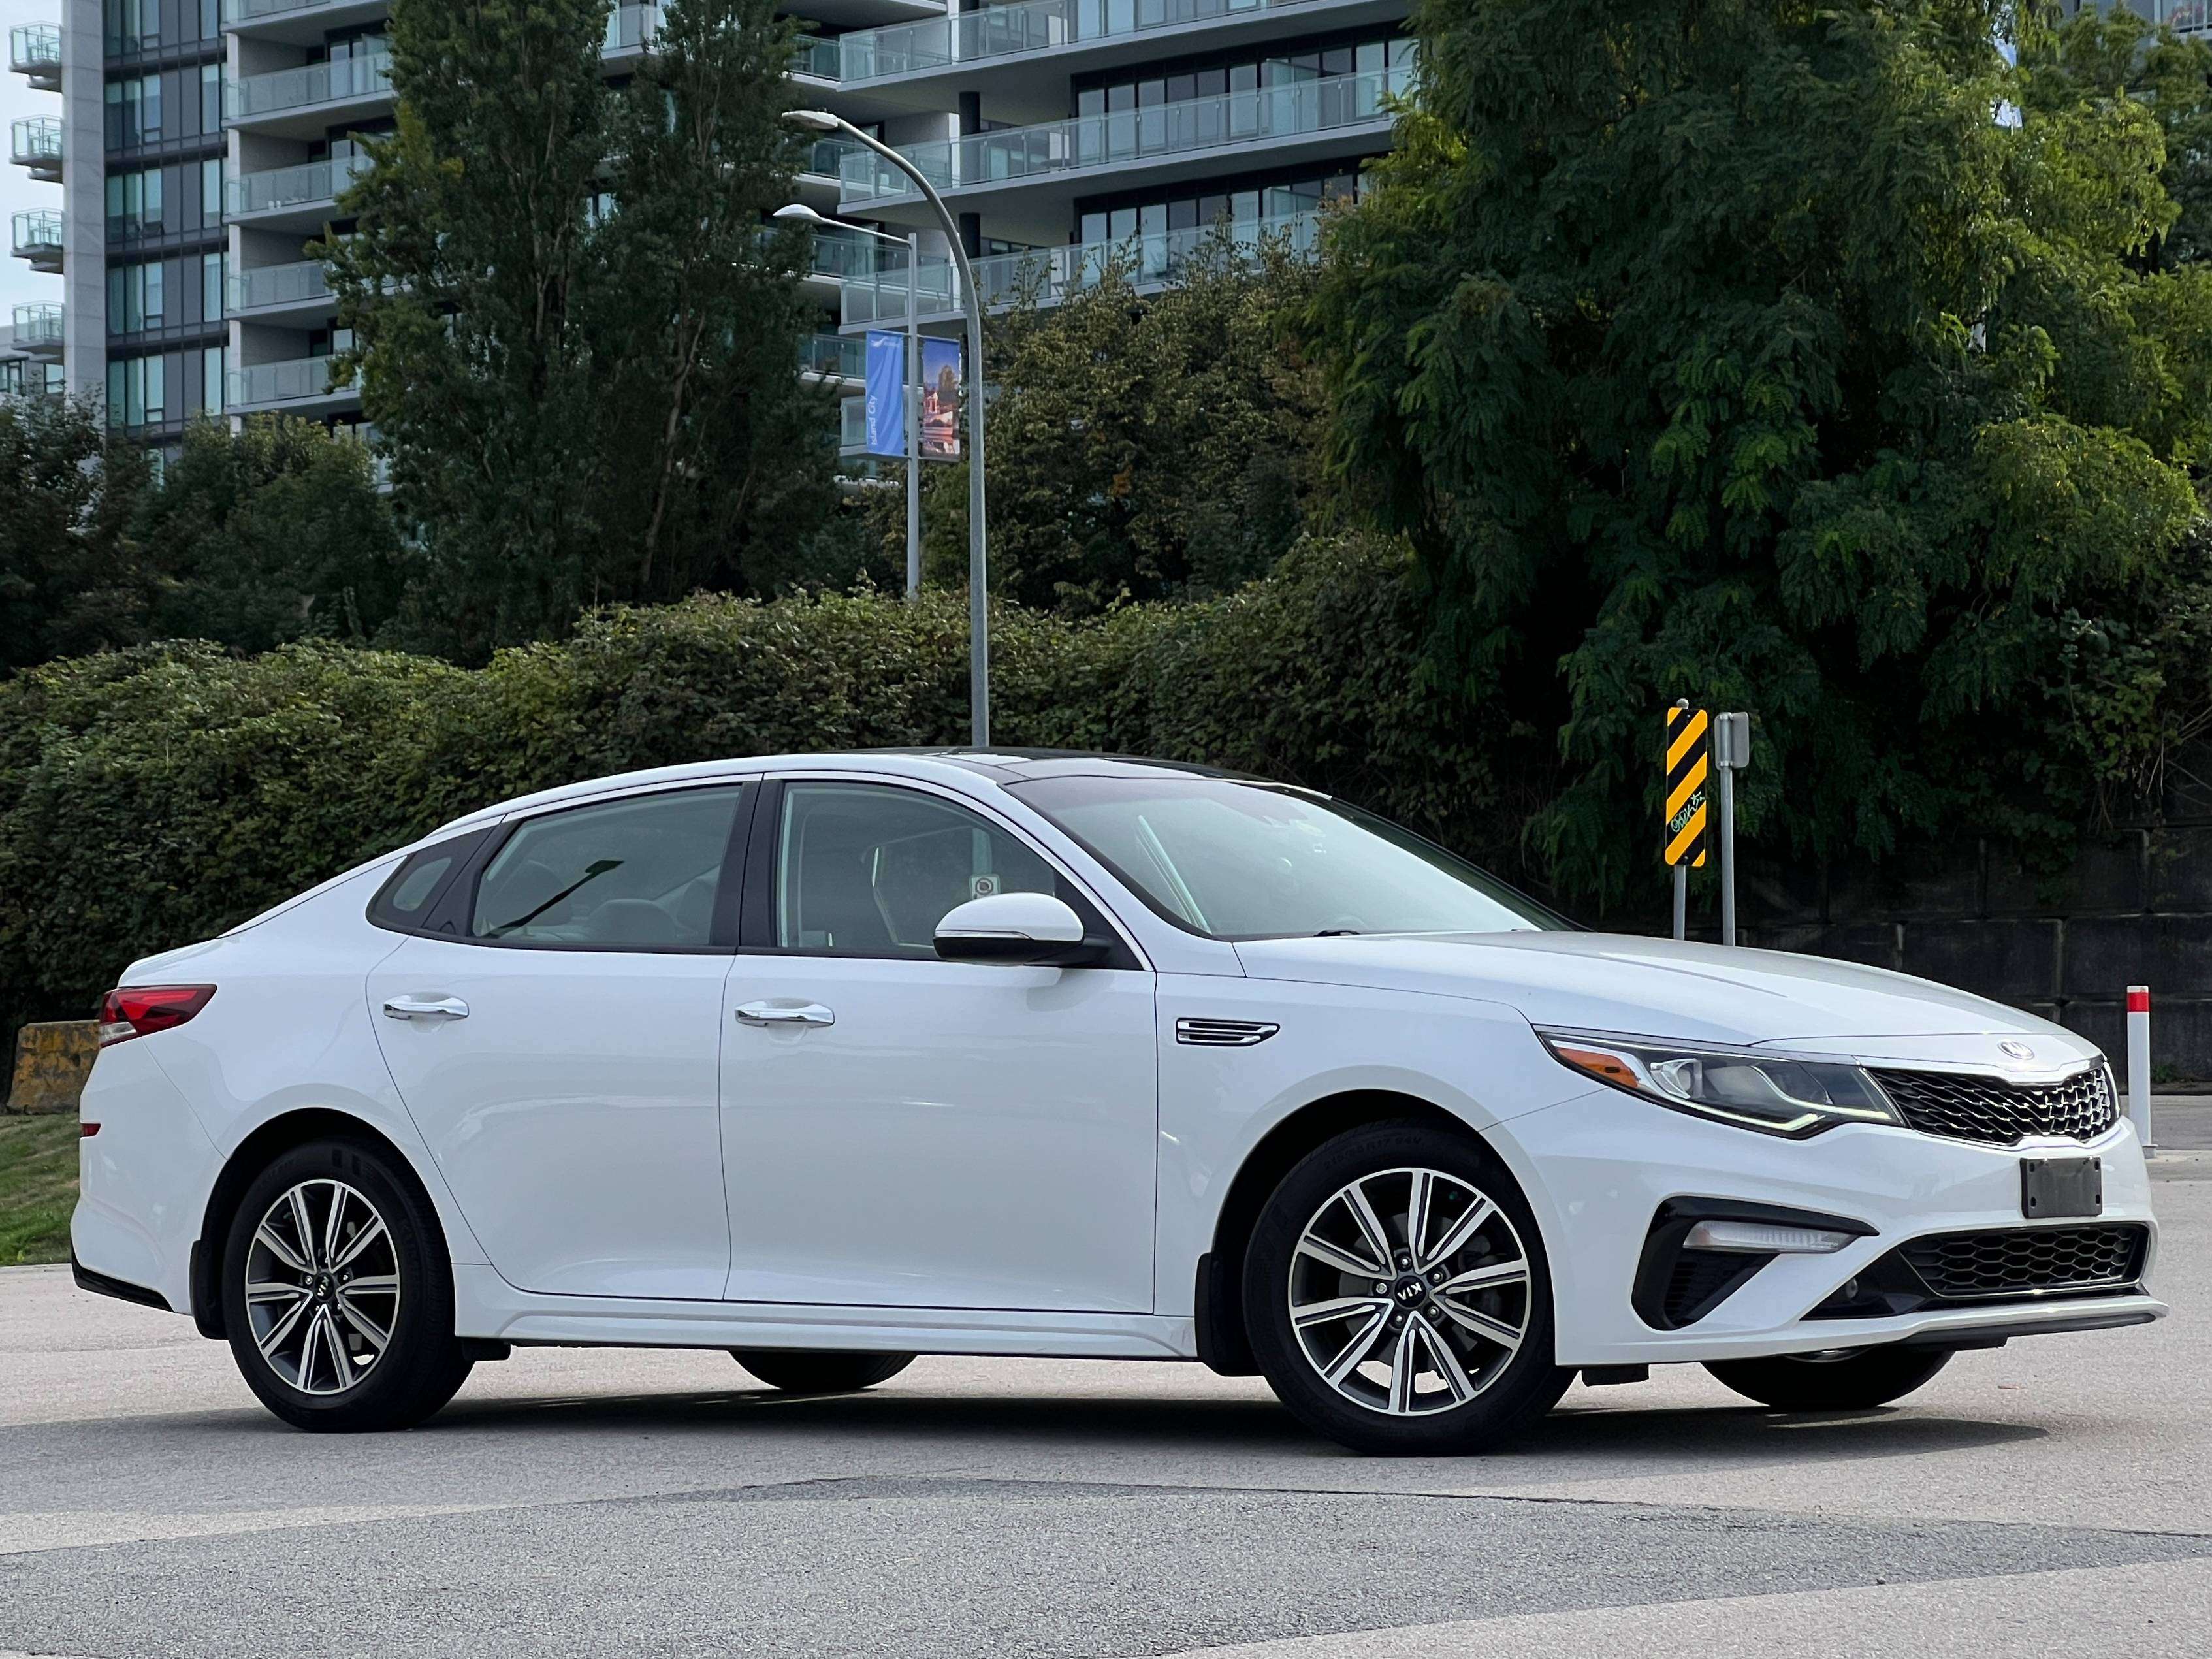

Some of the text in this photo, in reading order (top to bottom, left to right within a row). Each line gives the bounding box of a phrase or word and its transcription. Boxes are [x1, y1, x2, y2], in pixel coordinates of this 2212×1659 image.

[868, 395, 878, 445] Island City
[1397, 1282, 1422, 1300] KIA
